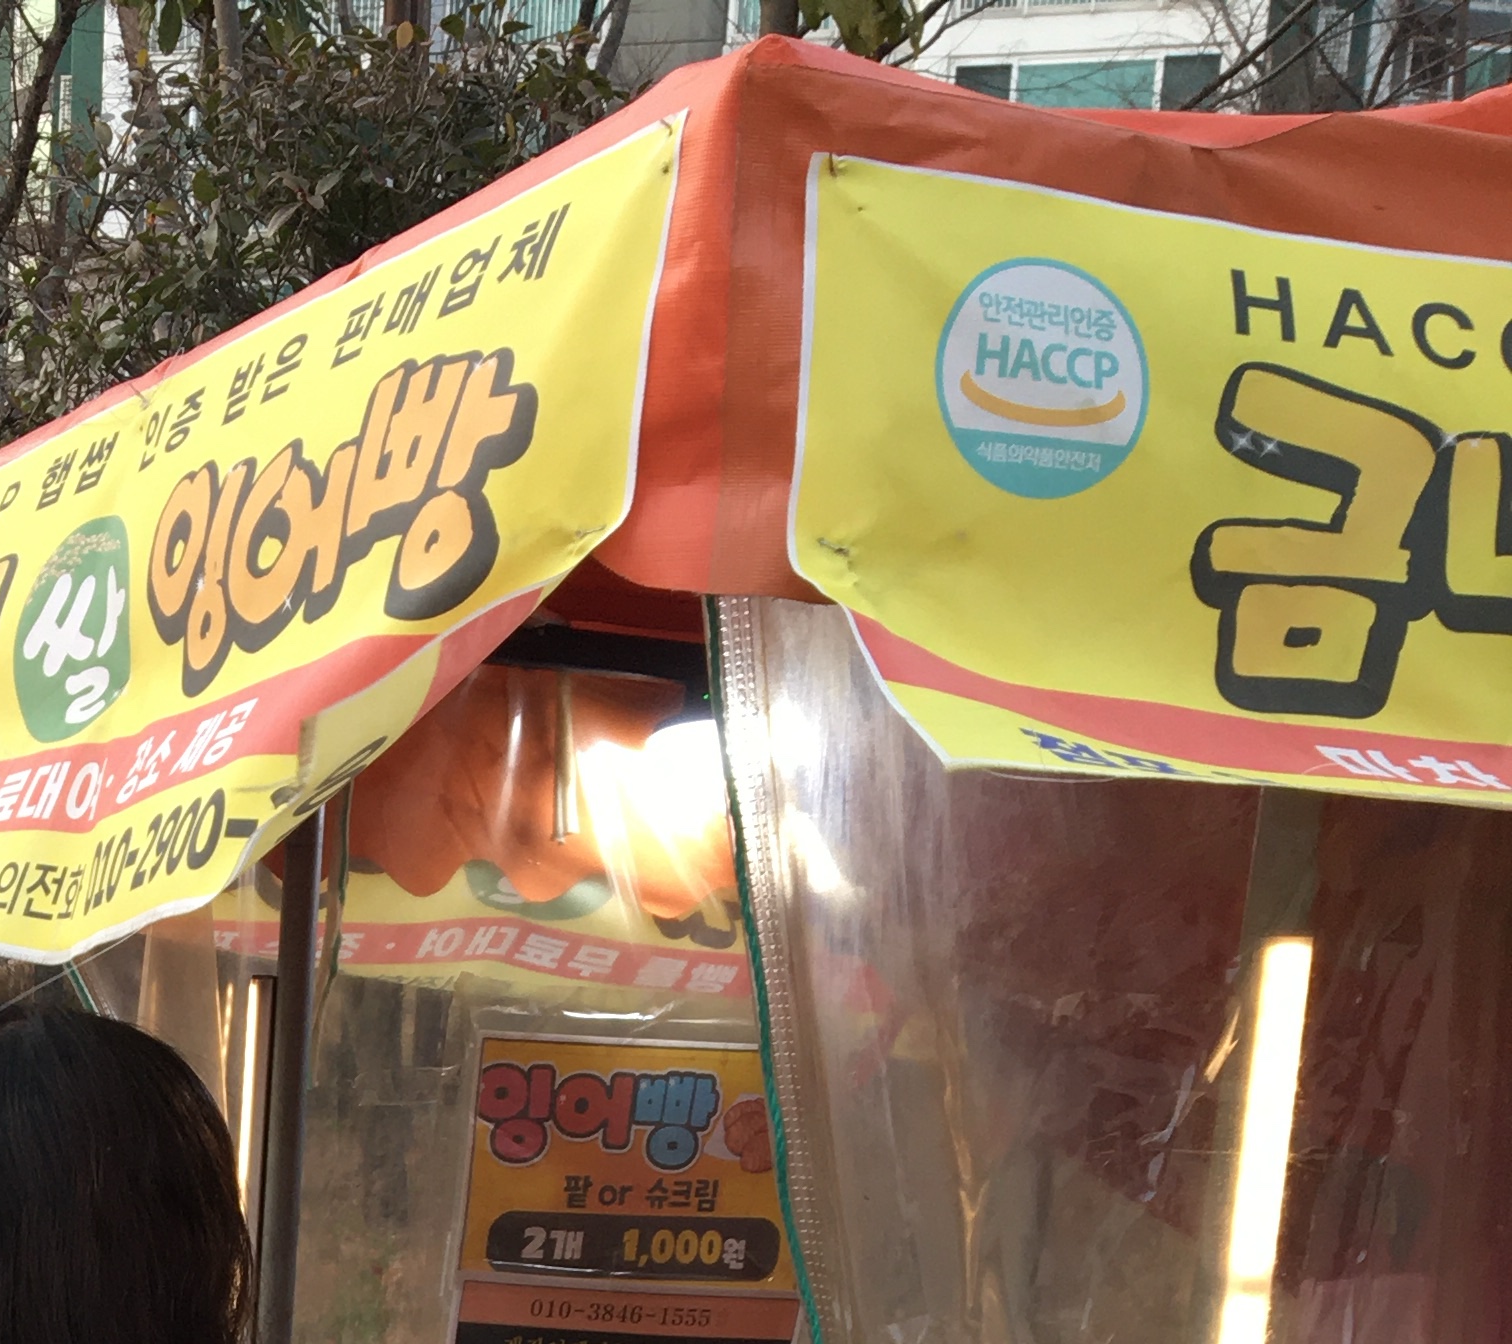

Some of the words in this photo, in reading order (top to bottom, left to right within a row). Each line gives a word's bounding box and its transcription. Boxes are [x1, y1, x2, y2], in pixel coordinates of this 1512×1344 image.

[979, 291, 1117, 342] 안전관리인증
[1231, 269, 1512, 370] HAC
[35, 430, 121, 512] 햅썹
[138, 386, 206, 472] 인증
[221, 333, 309, 426] 받은
[331, 202, 573, 369] 판매업체
[975, 332, 1120, 390] HACCP
[149, 347, 539, 698] 잉어빵
[116, 730, 177, 804] 장소
[169, 697, 259, 775] 제공
[1314, 744, 1511, 790] 마차
[477, 1063, 719, 1171] 잉어빵
[563, 1175, 592, 1209] 팥
[599, 1182, 633, 1208] or
[645, 1179, 720, 1213] 슈크림
[521, 1227, 585, 1261] 2개
[622, 1228, 747, 1271] 1,000원
[530, 1299, 712, 1328] 010-3846-1555
